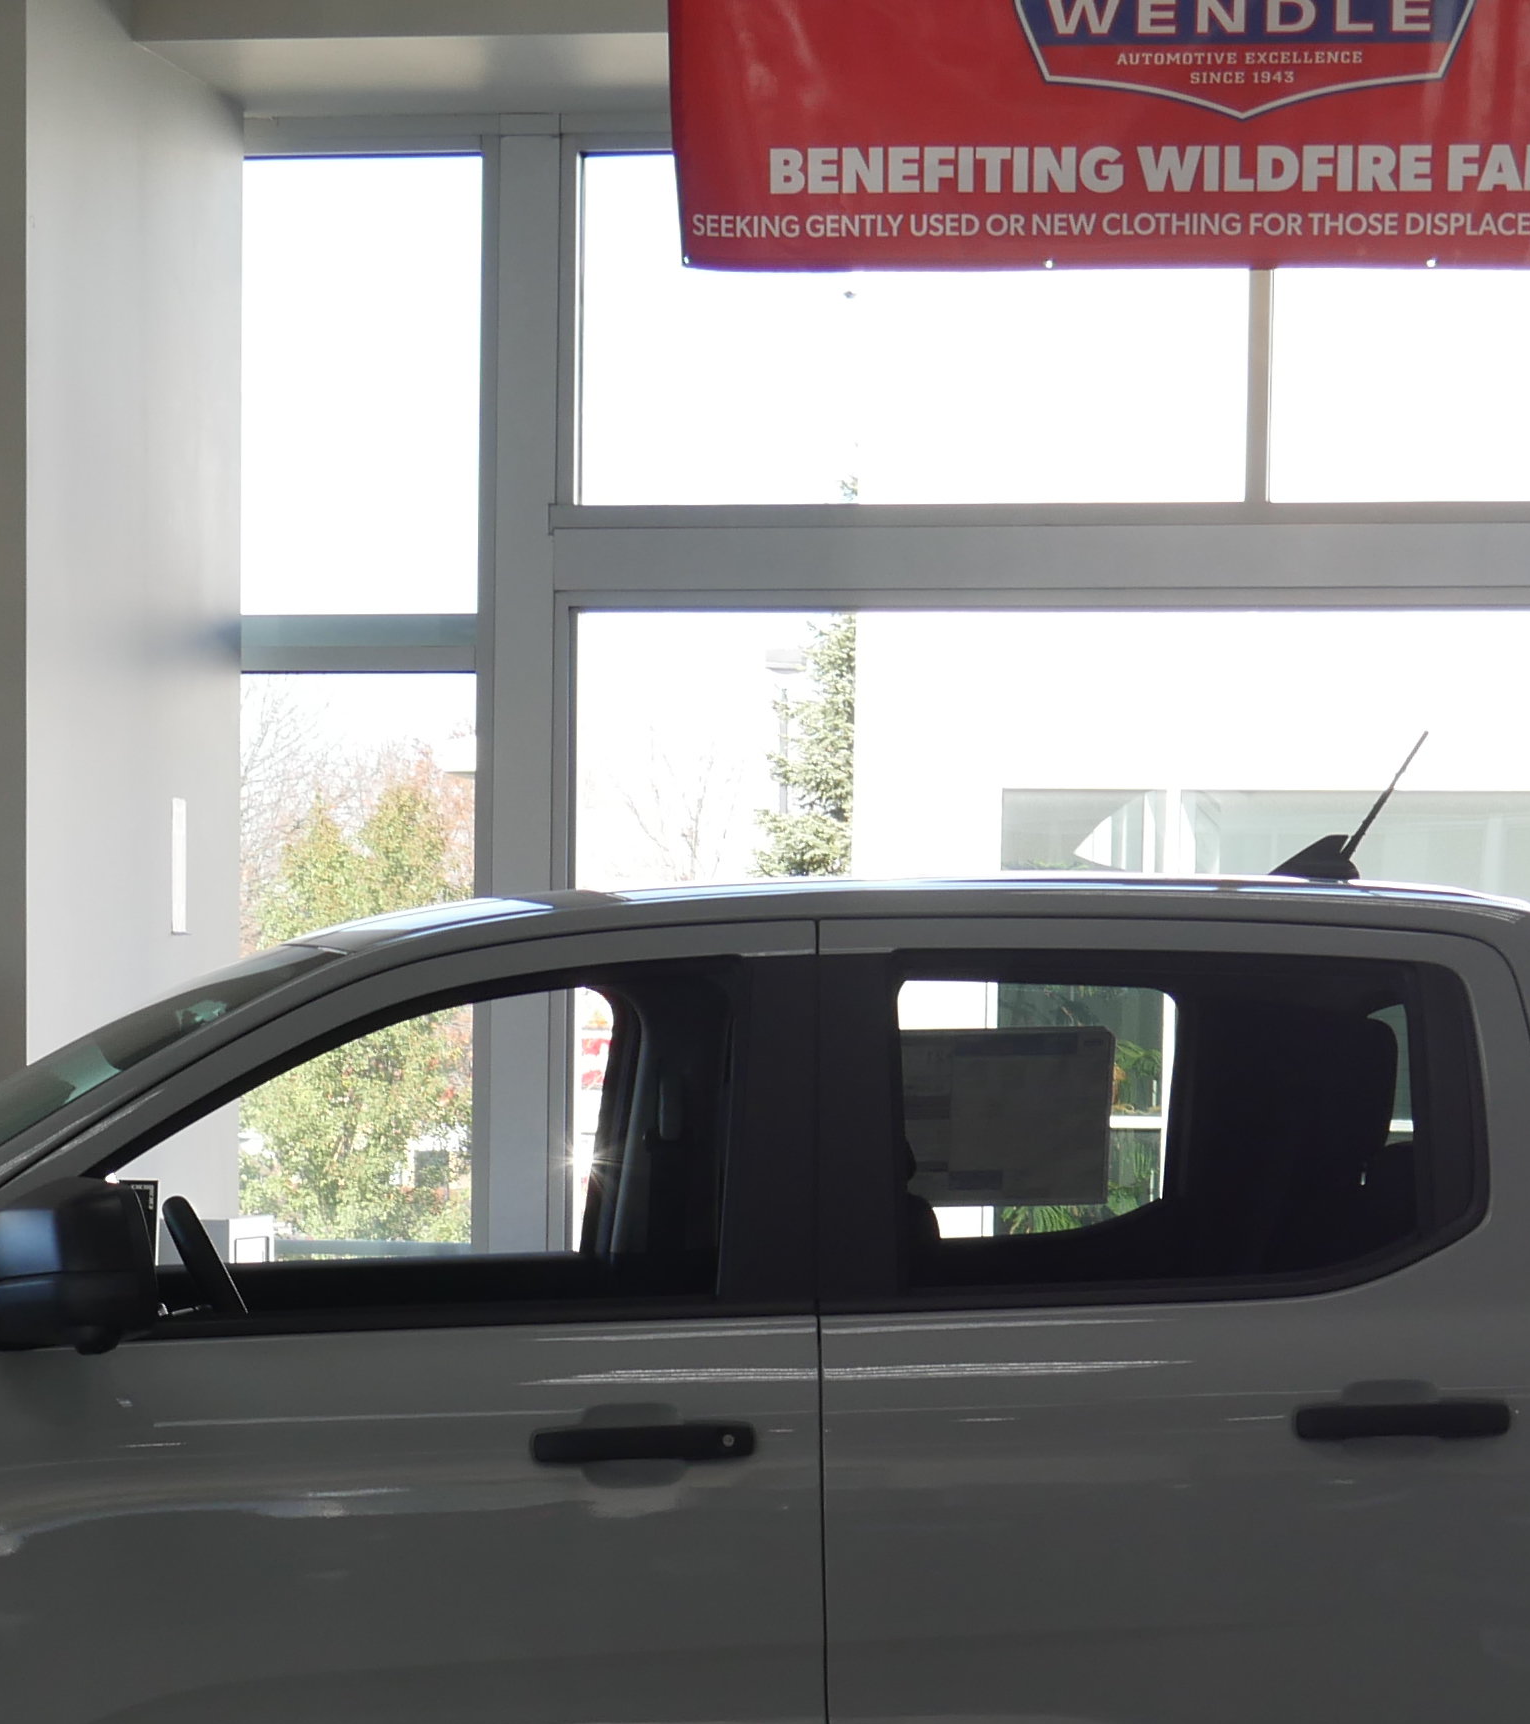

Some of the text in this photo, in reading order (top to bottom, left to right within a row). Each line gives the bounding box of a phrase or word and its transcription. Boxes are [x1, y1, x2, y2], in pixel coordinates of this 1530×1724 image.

[1049, 0, 1430, 34] WENDLE
[1117, 50, 1363, 65] AUTOMOTIVE EXCELLENCE
[1190, 71, 1295, 84] SINCE 1943
[769, 146, 1124, 194] BENEFITING
[1136, 145, 1433, 192] WILDFIRE
[692, 213, 801, 237] SEEKING
[805, 213, 904, 237] GENTLY
[910, 214, 980, 236] USED
[986, 213, 1026, 236] OR
[1032, 213, 1097, 236] NEW
[1102, 212, 1242, 236] CLOTHING
[1249, 212, 1302, 236] FOR
[1309, 213, 1399, 236] THOSE
